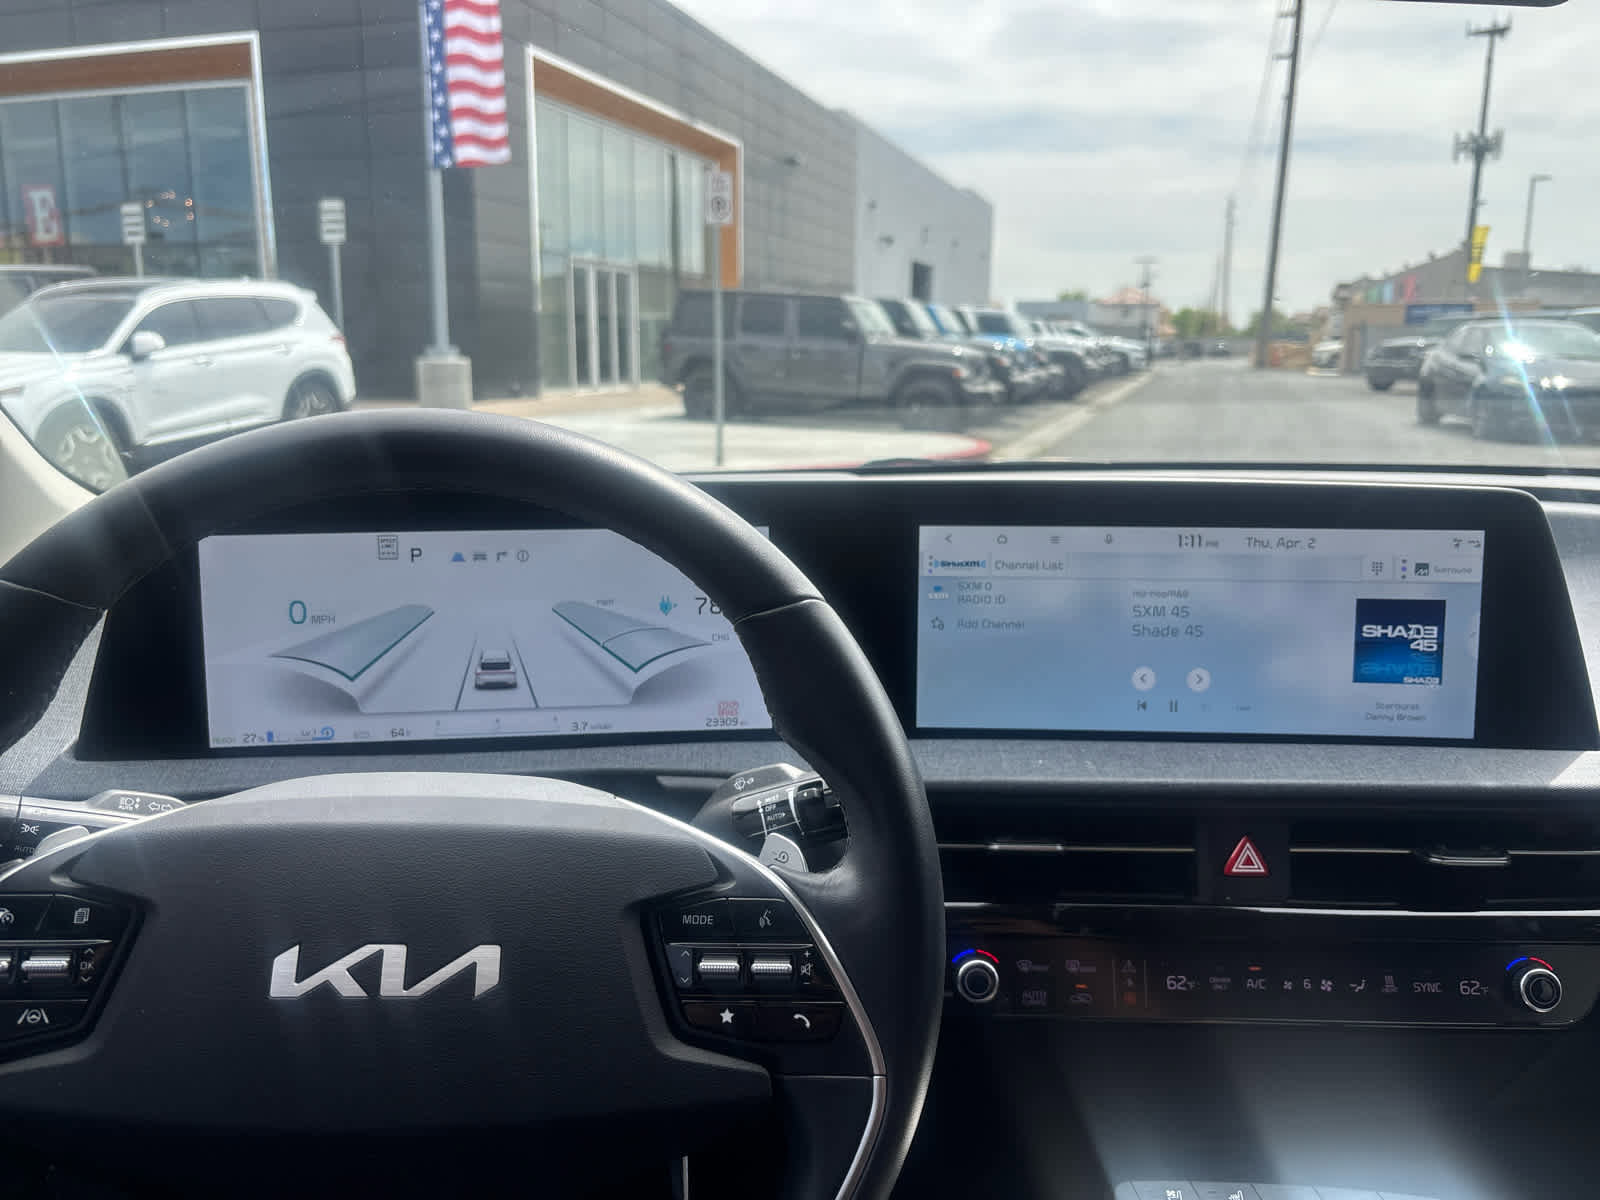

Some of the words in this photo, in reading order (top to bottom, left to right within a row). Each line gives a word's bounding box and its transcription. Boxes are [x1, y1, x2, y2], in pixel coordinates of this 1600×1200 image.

[1177, 534, 1203, 549] 1:11
[1306, 537, 1316, 549] 2
[410, 547, 423, 562] P
[994, 559, 1039, 571] Channel
[1042, 560, 1064, 571] List
[958, 594, 992, 605] RADIO
[288, 600, 308, 625] 0
[1132, 605, 1167, 618] SXM
[1170, 605, 1191, 618] 45
[310, 614, 336, 625] MPH
[957, 618, 979, 630] Add
[981, 618, 1026, 630] Channel
[1131, 624, 1179, 638] Shade
[1183, 625, 1205, 638] 45
[1361, 623, 1439, 640] SHADE
[1409, 638, 1439, 652] 45
[571, 721, 588, 732] 3.7
[765, 804, 776, 812] OFF
[682, 914, 714, 925] MODE
[80, 961, 95, 970] OK
[1246, 979, 1266, 991] A/C
[1303, 979, 1312, 990] 6
[1413, 981, 1442, 993] SYNC
